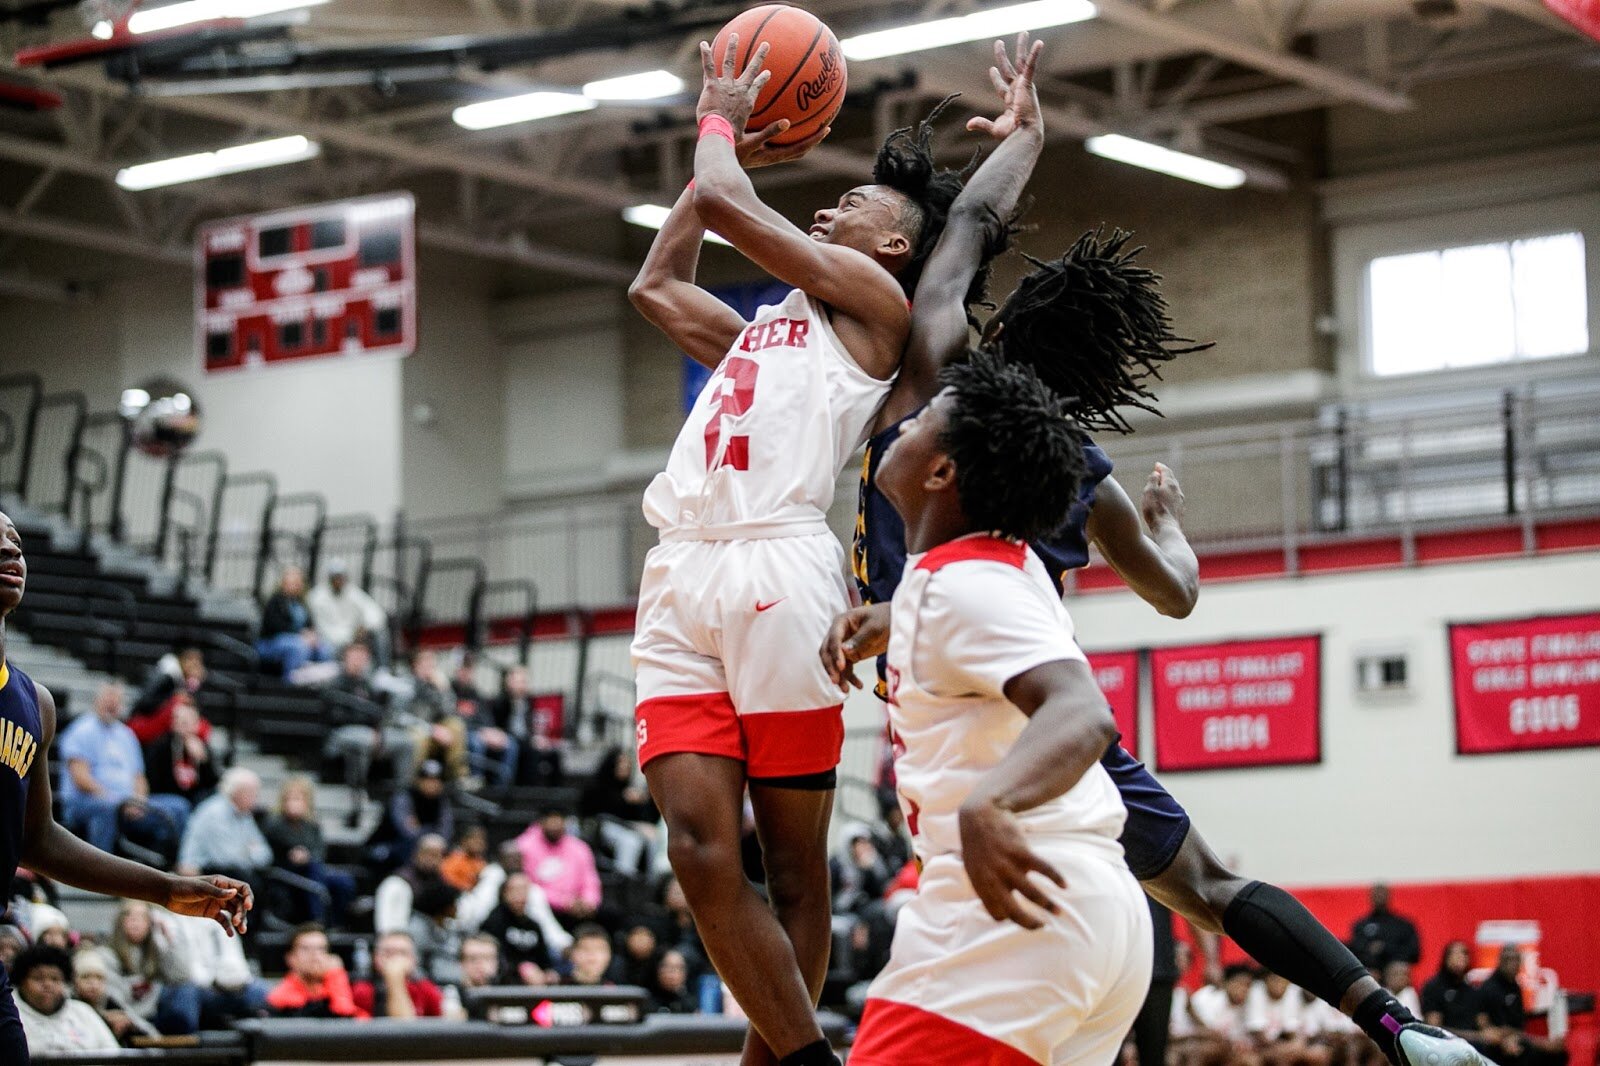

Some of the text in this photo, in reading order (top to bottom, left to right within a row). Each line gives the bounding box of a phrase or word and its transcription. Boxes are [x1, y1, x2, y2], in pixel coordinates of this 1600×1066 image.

[1466, 636, 1526, 666] STATE
[1164, 652, 1304, 687] STATE FINALIST
[1473, 664, 1527, 693] GIRLS
